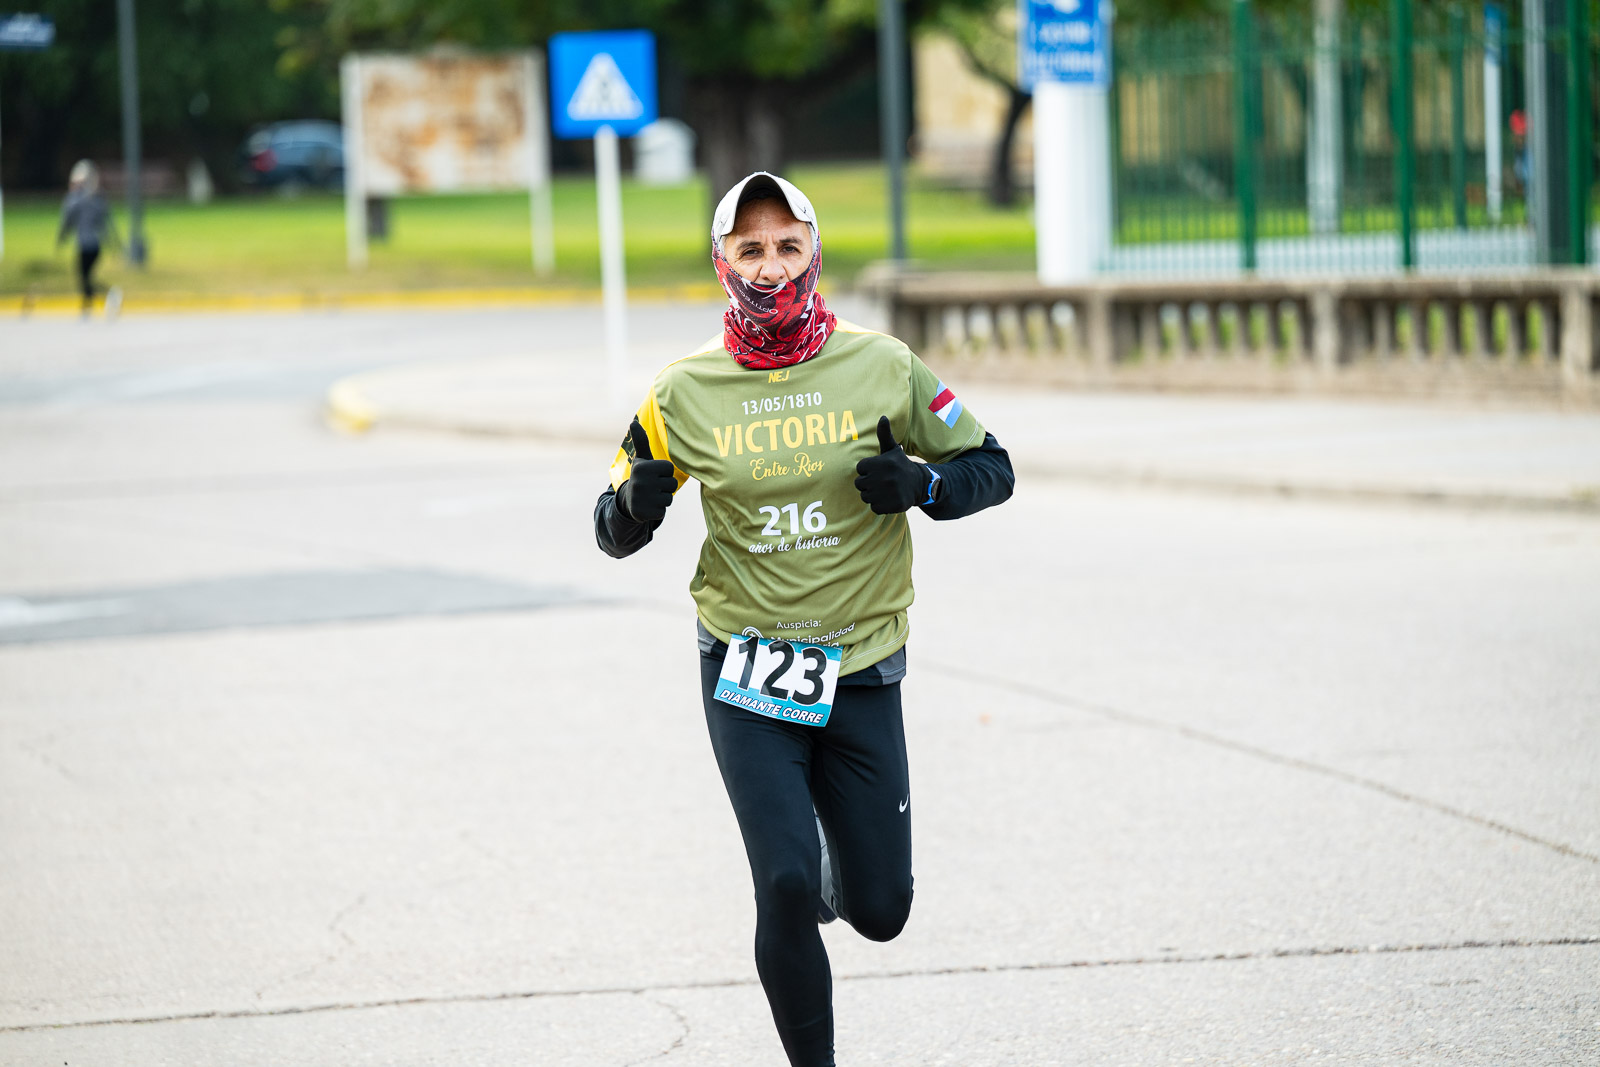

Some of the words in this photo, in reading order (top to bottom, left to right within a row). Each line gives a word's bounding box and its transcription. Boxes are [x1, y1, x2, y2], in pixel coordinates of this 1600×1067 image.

[768, 370, 790, 383] NEJ
[742, 391, 822, 415] 13/05/1810
[712, 410, 859, 457] VICTORIA
[749, 458, 790, 481] Entre
[758, 500, 827, 536] 216
[748, 541, 775, 554] años
[777, 537, 793, 552] de
[795, 535, 842, 550] historia
[770, 622, 856, 645] nicipalidad
[776, 619, 822, 631] Auspicia:
[738, 636, 828, 706] 123
[719, 688, 783, 716] DIAMANTE
[782, 706, 825, 724] CORRE
